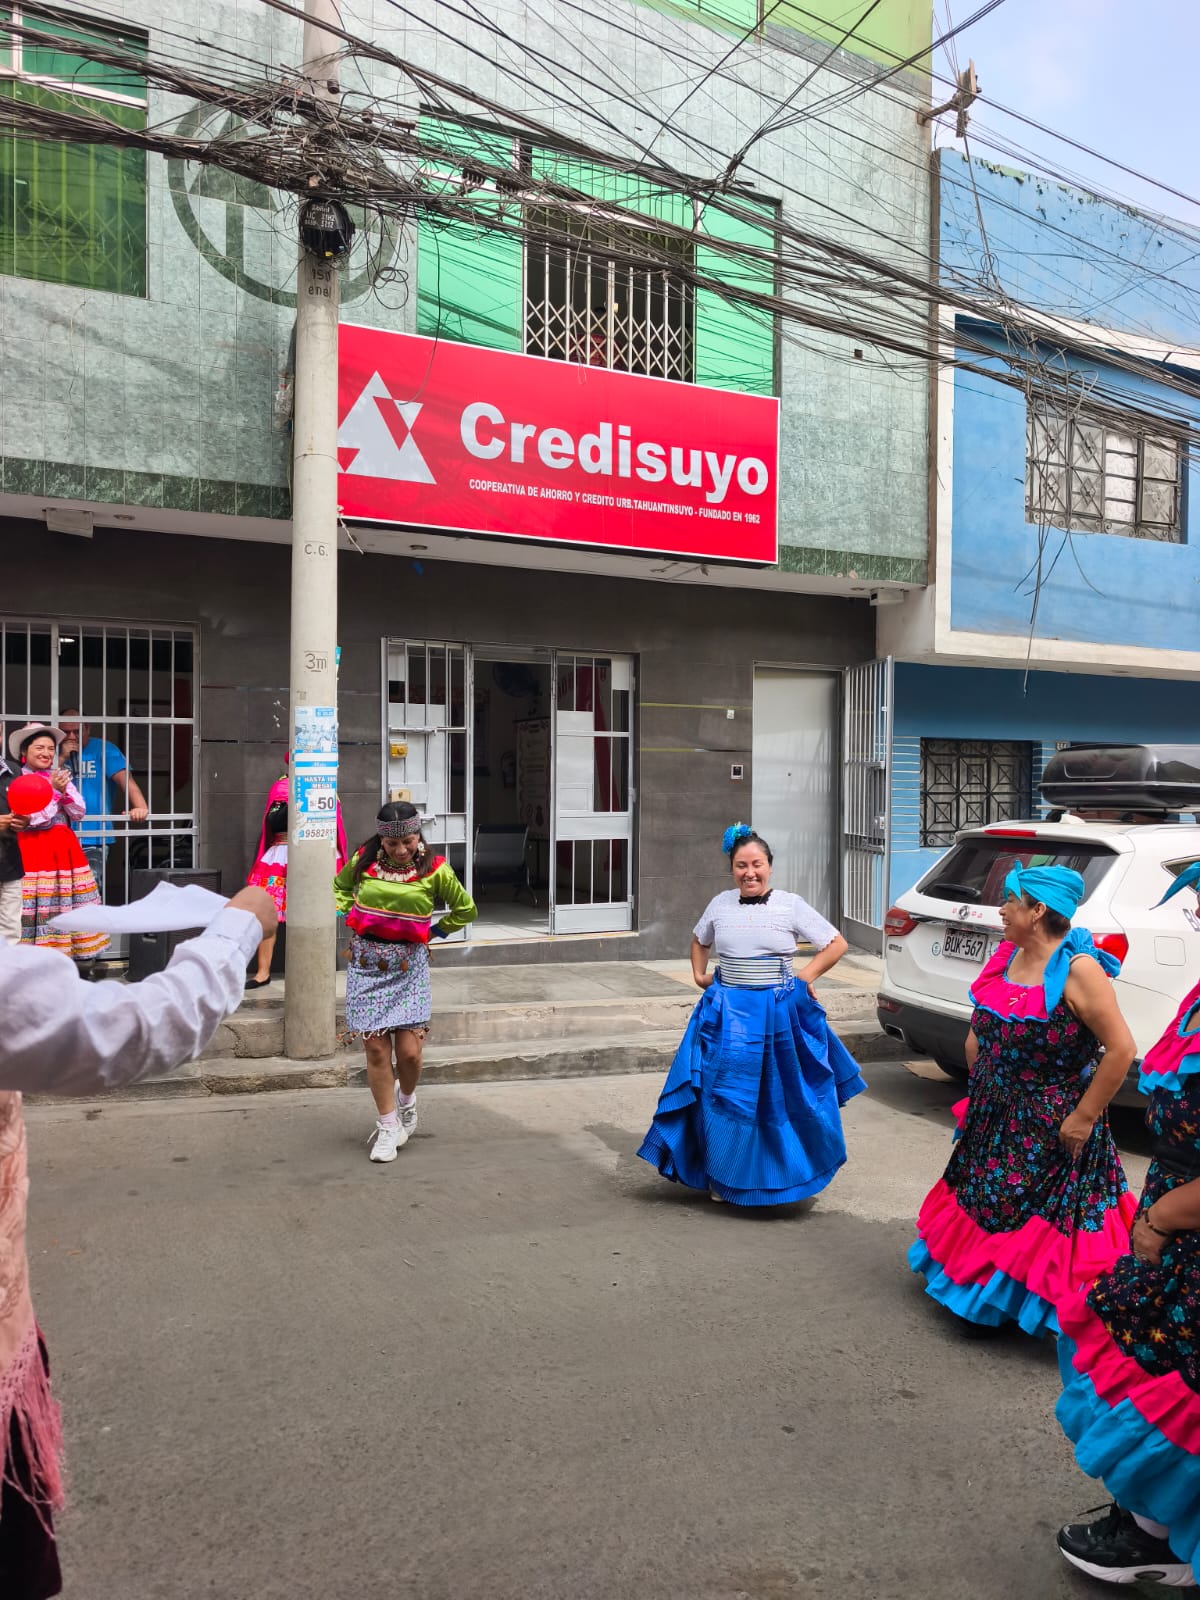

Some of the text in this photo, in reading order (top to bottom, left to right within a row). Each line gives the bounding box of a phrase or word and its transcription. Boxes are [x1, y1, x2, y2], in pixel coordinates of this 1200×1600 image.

[308, 286, 332, 298] enel
[460, 402, 768, 504] Credisuyo
[469, 479, 526, 496] COOPERATIVA
[527, 486, 538, 498] DE
[540, 487, 573, 502] AHORRO
[574, 491, 580, 502] Y
[582, 493, 614, 507] CREDITO
[699, 507, 731, 521] FUNDADO
[732, 512, 742, 523] EN
[744, 514, 761, 524] 1962
[317, 796, 334, 810] 50
[944, 935, 984, 957] BUK-567
